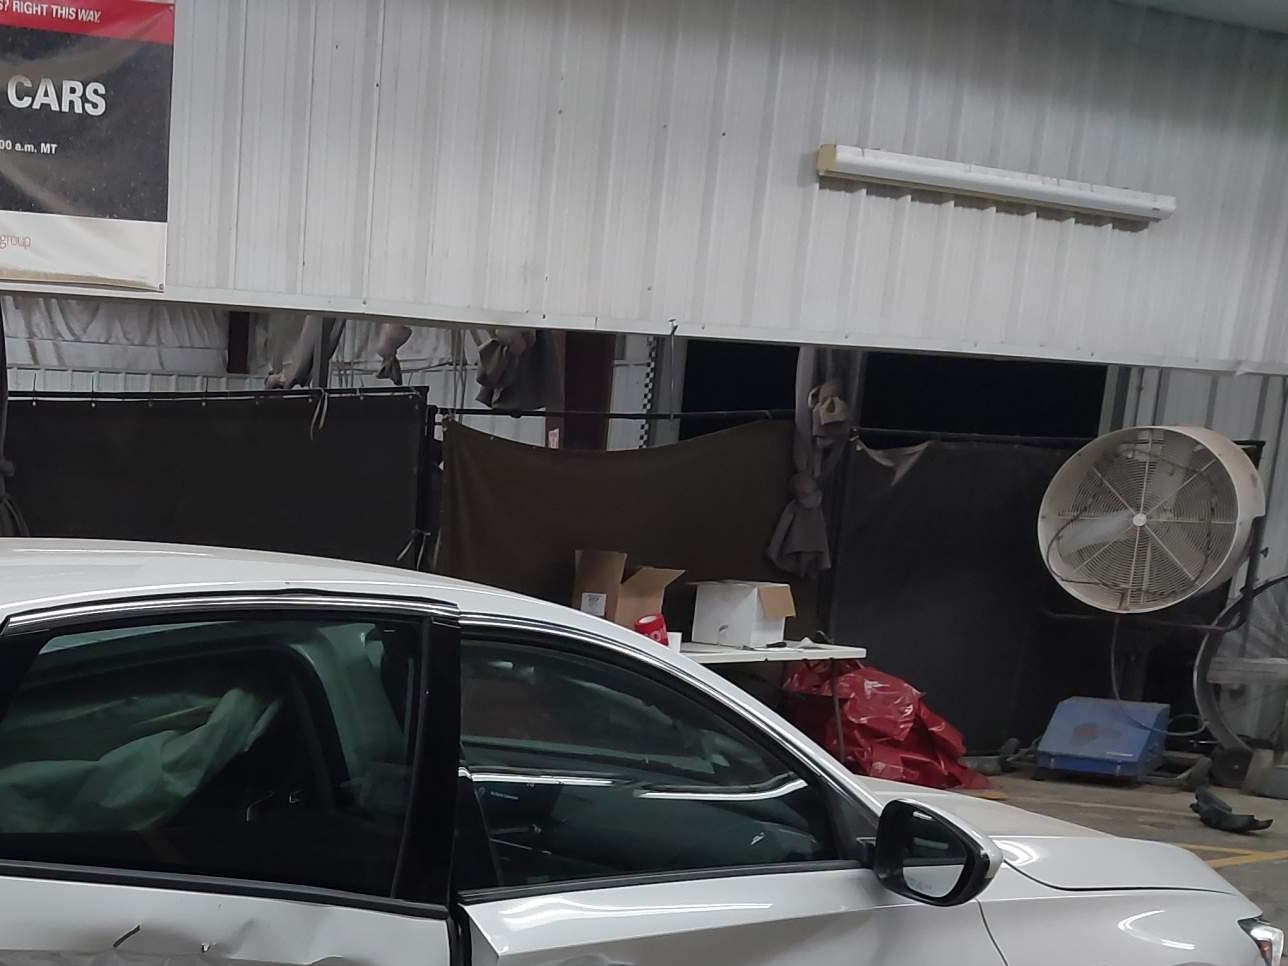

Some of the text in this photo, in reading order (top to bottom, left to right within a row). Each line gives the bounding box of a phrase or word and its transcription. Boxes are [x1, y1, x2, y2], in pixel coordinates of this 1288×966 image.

[12, 0, 48, 16] RIGHT
[51, 5, 76, 20] THIS
[7, 75, 106, 117] CARS
[15, 143, 38, 153] a.m.
[40, 142, 58, 154] MT
[0, 232, 32, 250] group
